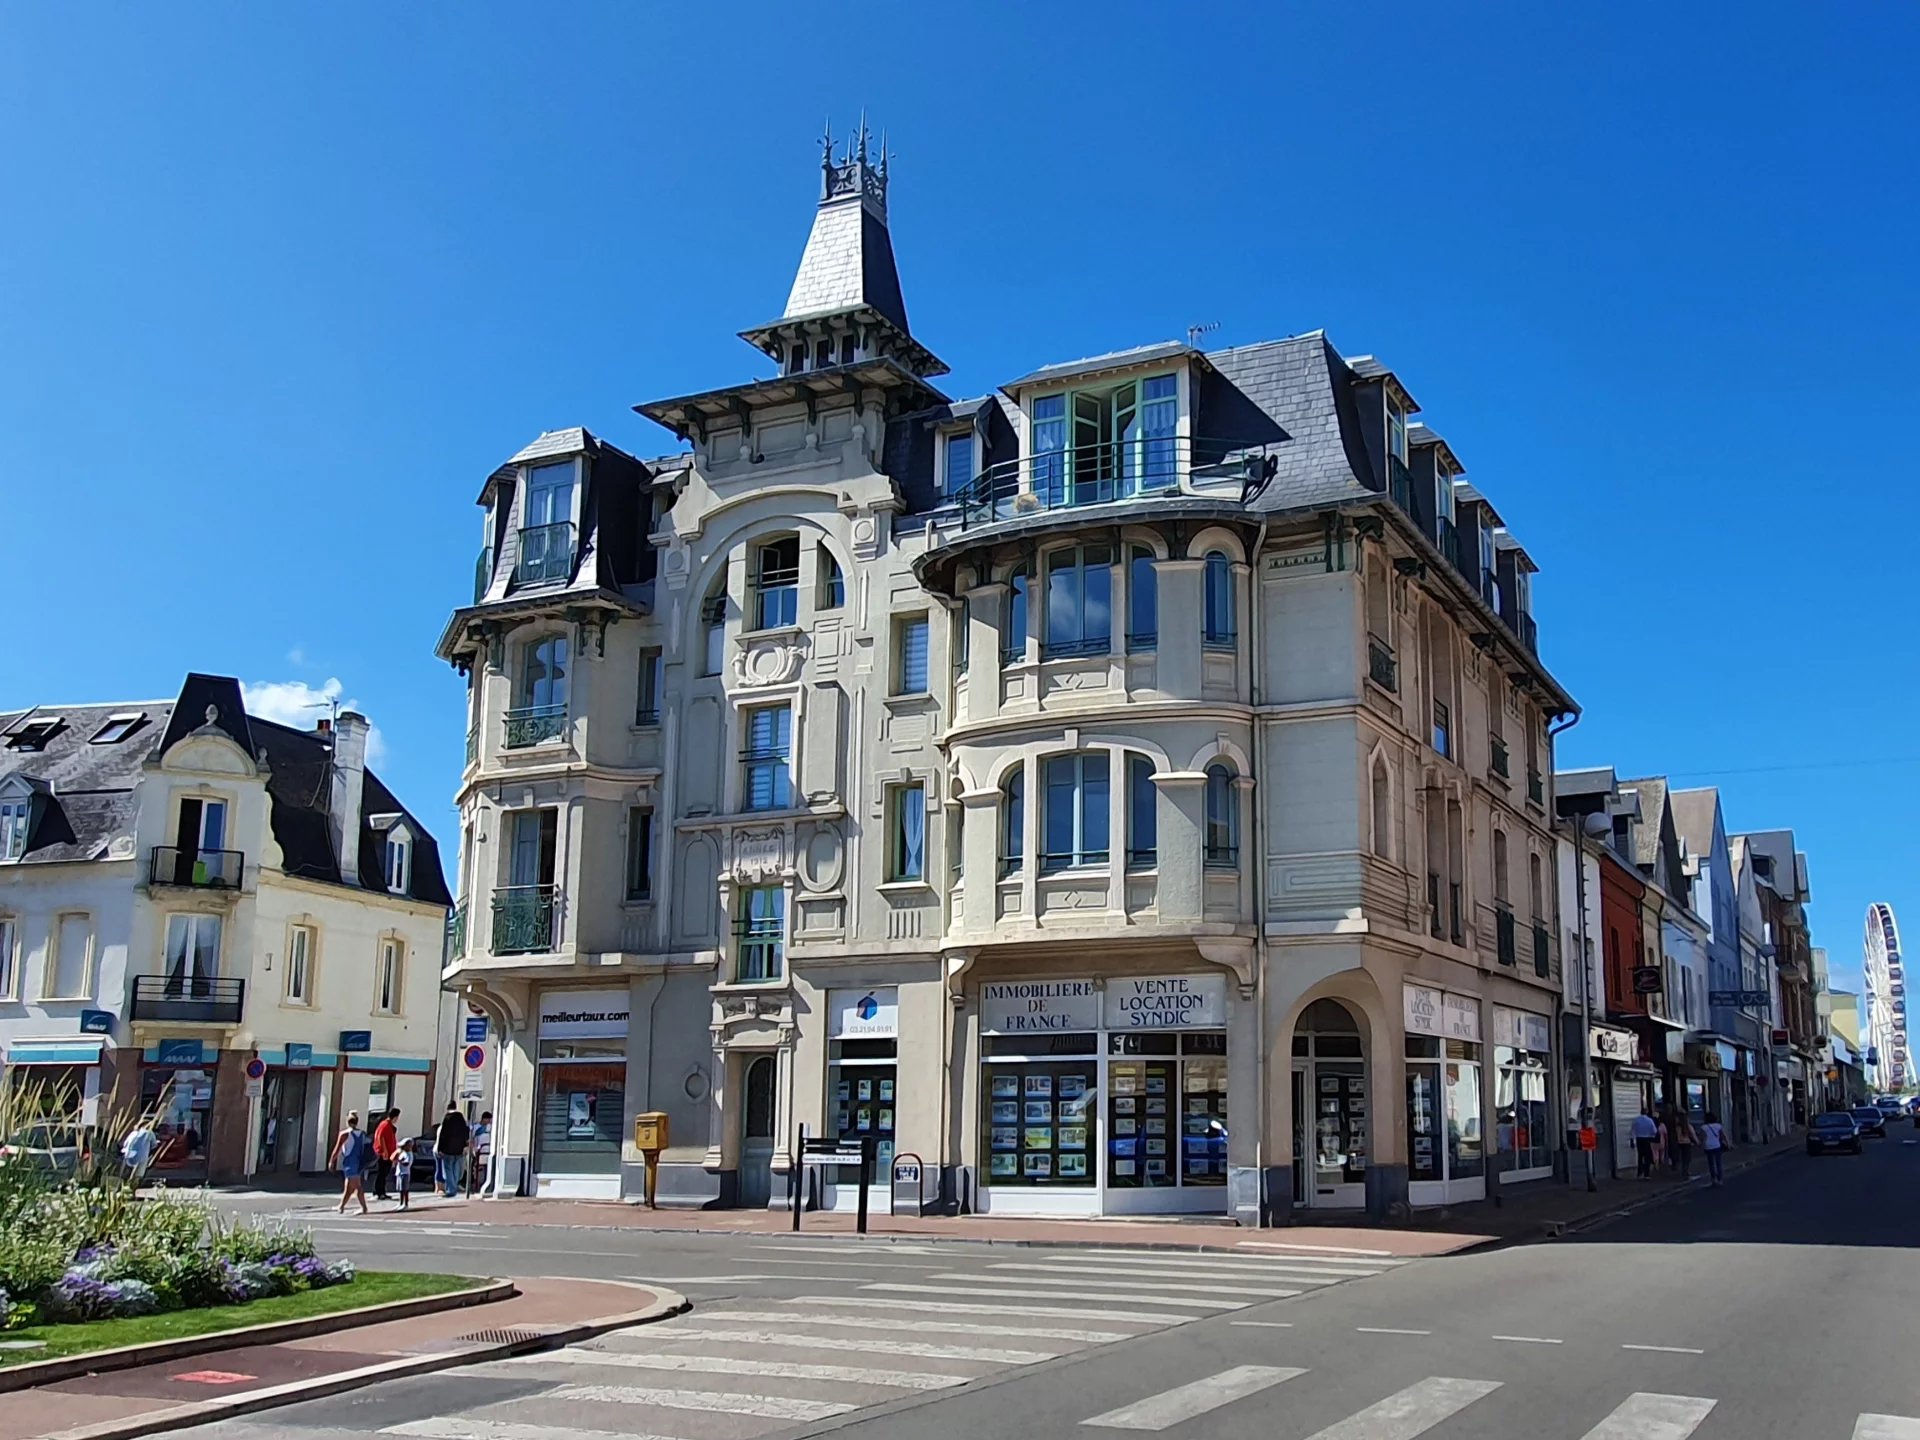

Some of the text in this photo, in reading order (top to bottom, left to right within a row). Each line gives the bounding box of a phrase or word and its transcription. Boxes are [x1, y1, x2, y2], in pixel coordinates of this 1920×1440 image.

[985, 983, 1094, 999] IMMOBILIERE
[1134, 980, 1188, 994] VENTE
[1028, 1000, 1048, 1012] DE
[1120, 995, 1203, 1010] LOCATION
[542, 1011, 630, 1023] meilleurtaux.com
[1006, 1015, 1071, 1029] FRANCE
[1131, 1010, 1191, 1026] SYNDIC
